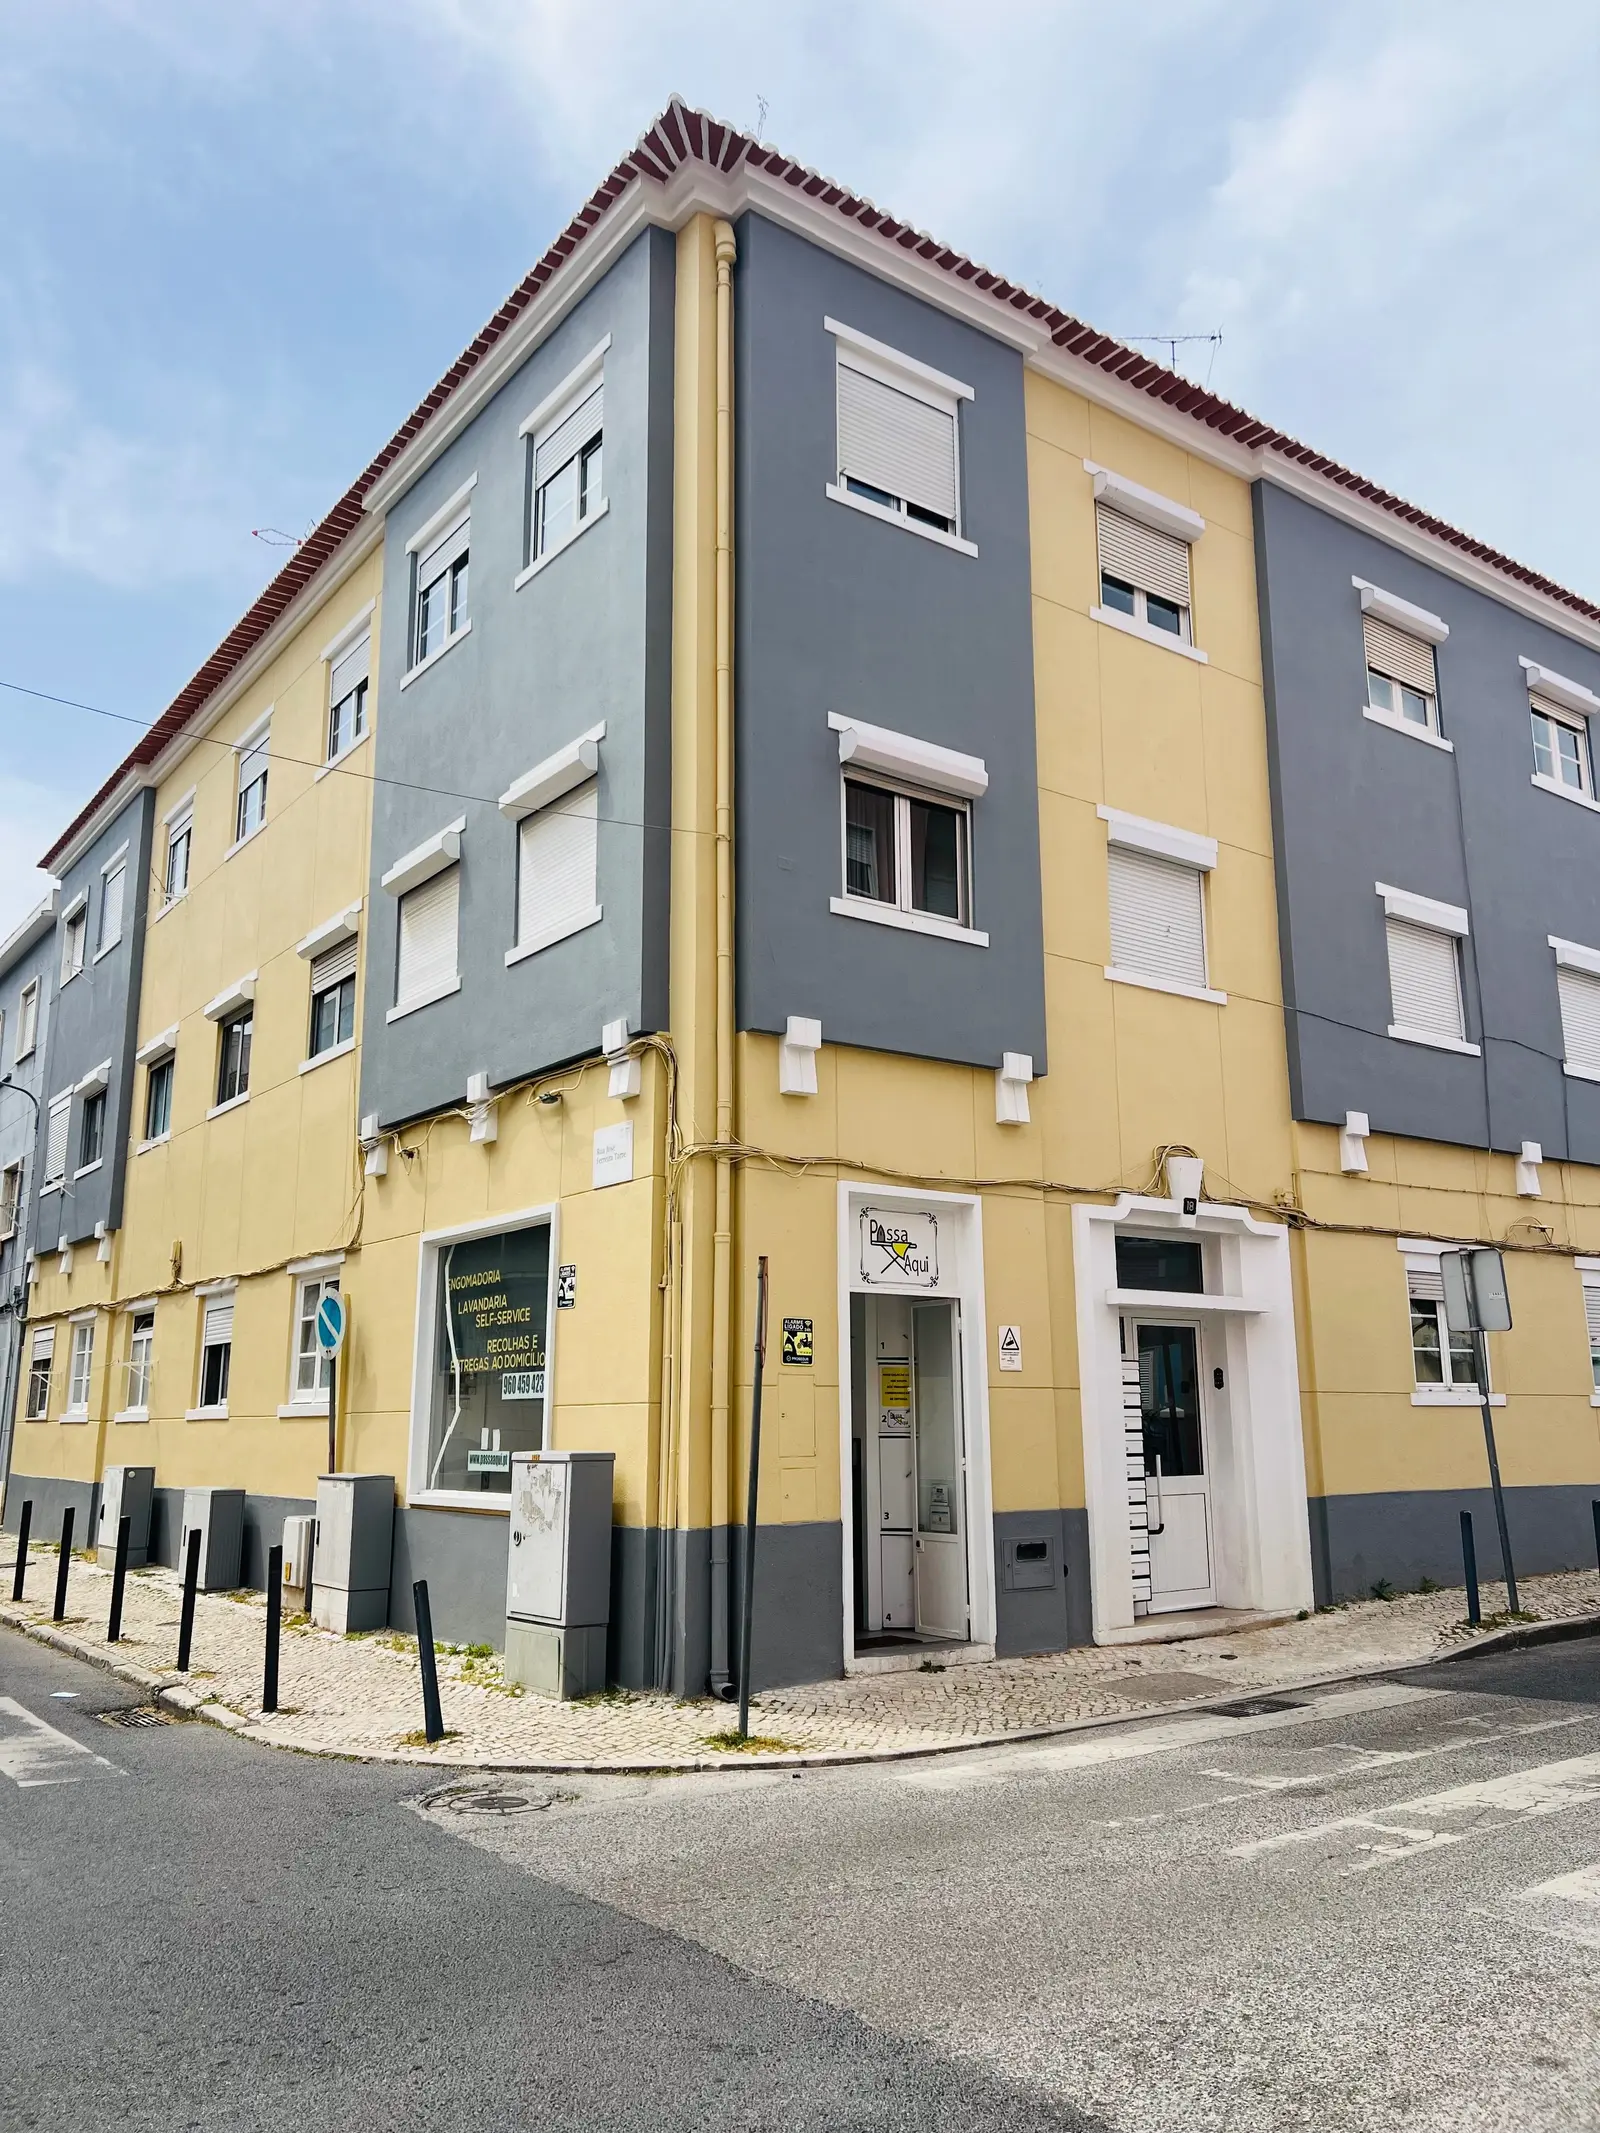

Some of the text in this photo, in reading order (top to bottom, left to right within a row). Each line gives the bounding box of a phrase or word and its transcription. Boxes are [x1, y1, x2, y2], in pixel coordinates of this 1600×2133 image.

[1186, 1200, 1194, 1212] 18
[904, 1255, 929, 1276] Aqui
[458, 1294, 508, 1315] LAVANDARIA
[475, 1307, 531, 1328] SELF-SERVICE
[487, 1334, 538, 1353] RECOLHAS E
[880, 1341, 885, 1350] 1
[450, 1349, 546, 1373] ETREGAS AO DOMICÍLIO
[503, 1373, 545, 1395] 960 459 423
[881, 1415, 887, 1423] 2
[884, 1512, 890, 1520] 3
[885, 1613, 891, 1621] 4
